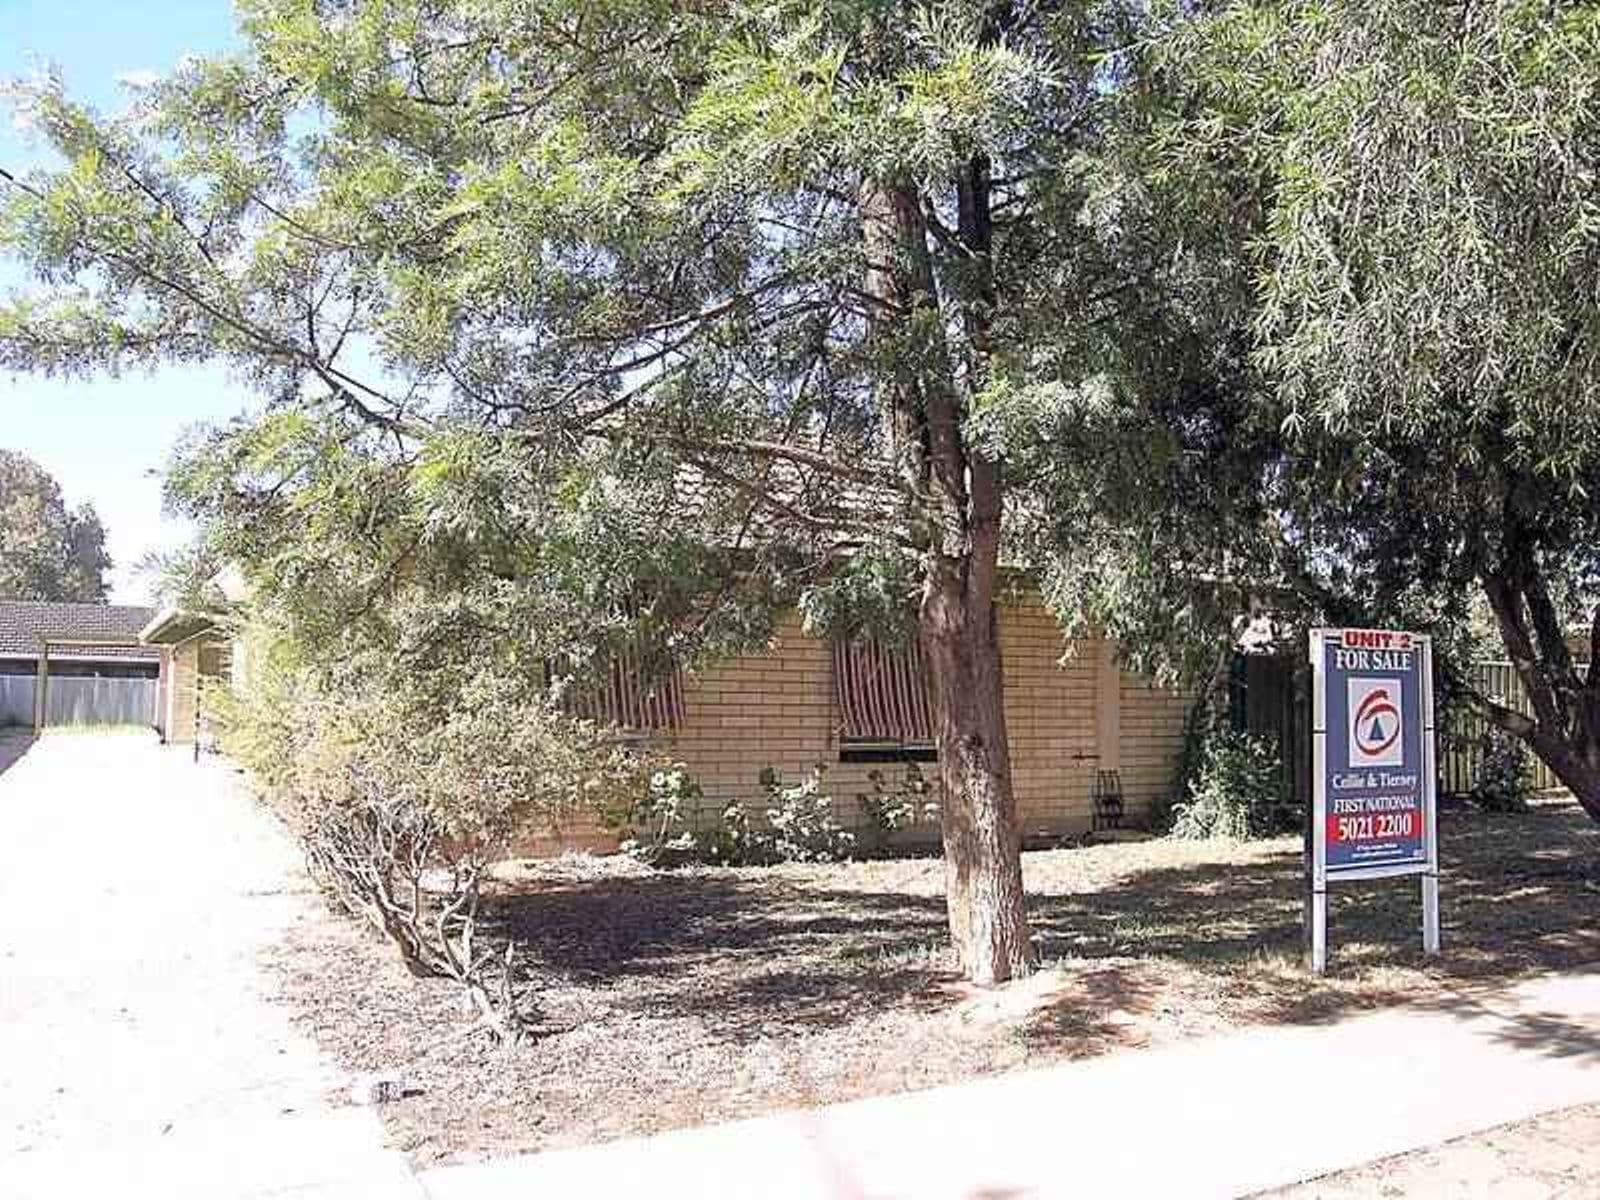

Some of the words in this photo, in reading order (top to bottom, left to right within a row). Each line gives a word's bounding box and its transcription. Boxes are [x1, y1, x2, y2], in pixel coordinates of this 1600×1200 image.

[1344, 631, 1393, 648] UNIT
[1336, 650, 1370, 670] FOR
[1372, 652, 1412, 671] SALE
[1367, 772, 1378, 788] &
[1334, 799, 1366, 814] FIRST
[1366, 795, 1416, 812] NATIONAL
[1339, 816, 1374, 841] 5021
[1376, 812, 1413, 837] 2200
